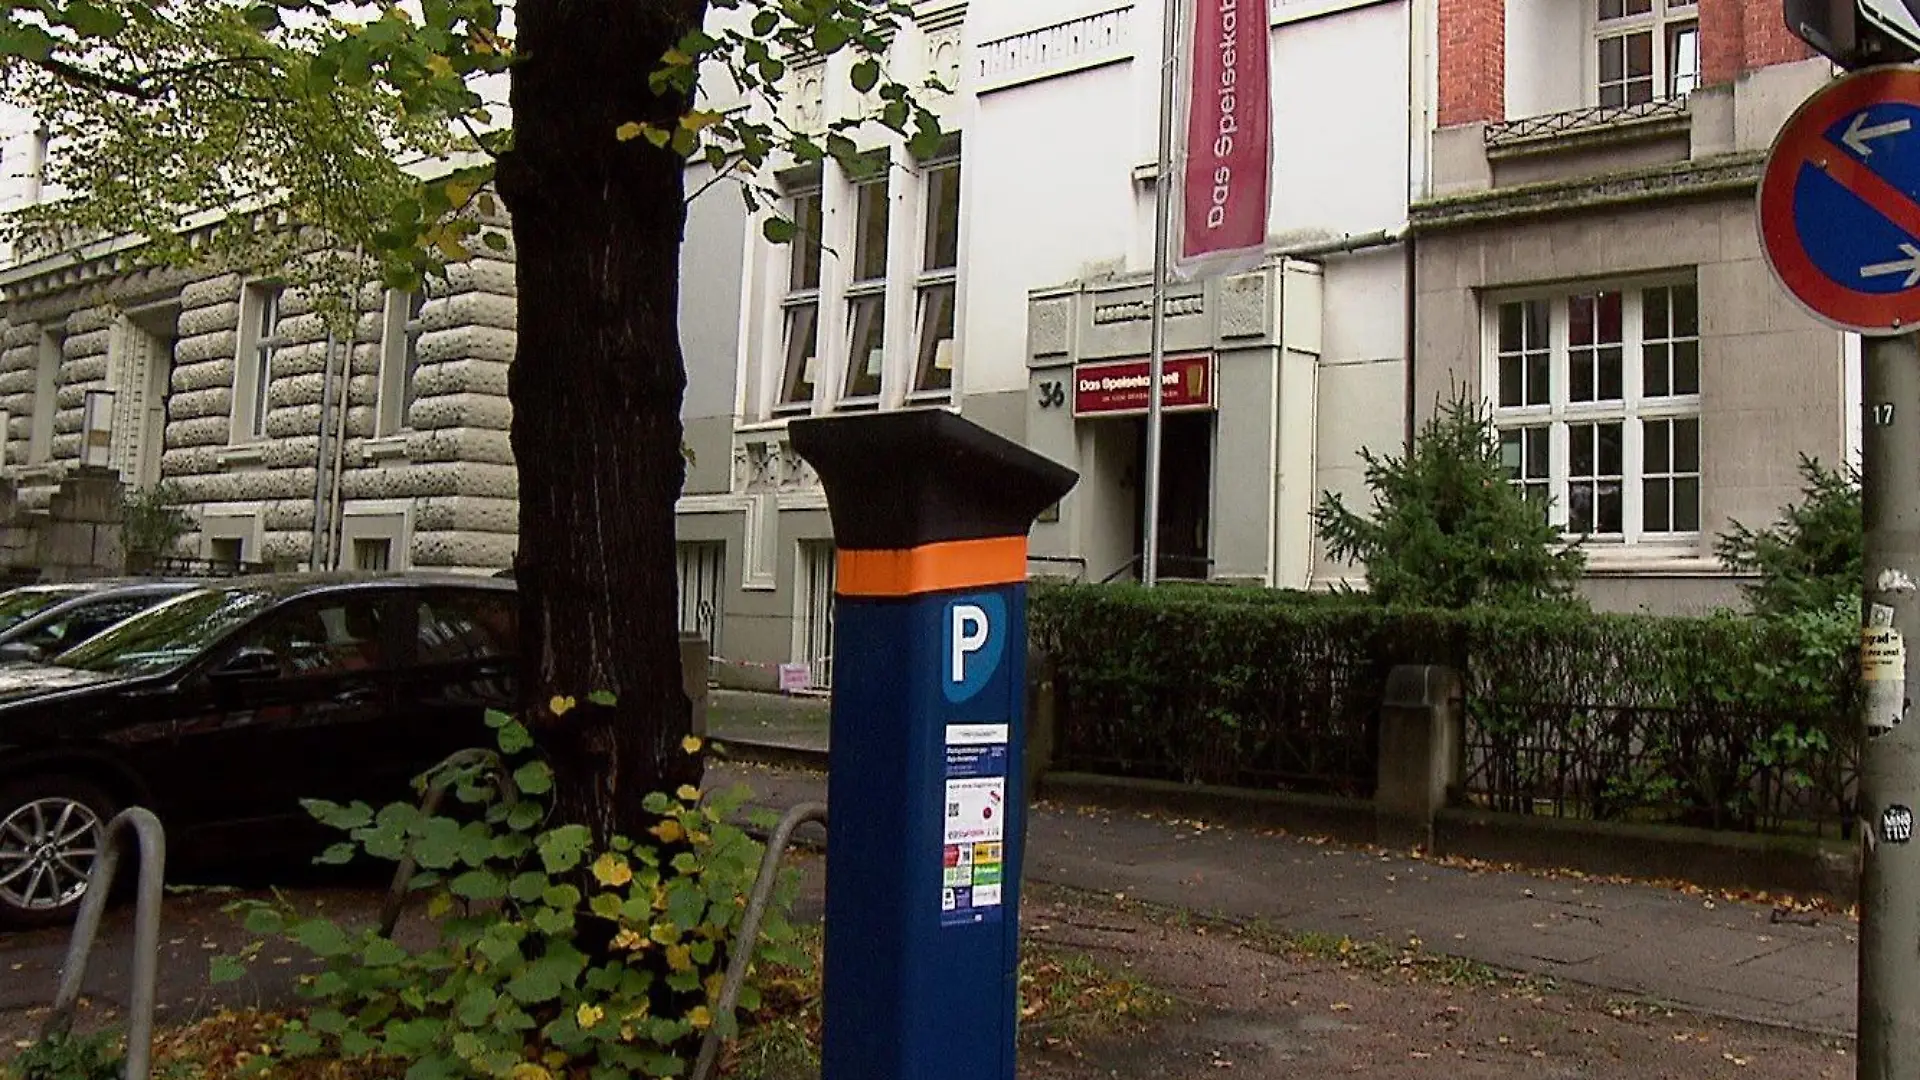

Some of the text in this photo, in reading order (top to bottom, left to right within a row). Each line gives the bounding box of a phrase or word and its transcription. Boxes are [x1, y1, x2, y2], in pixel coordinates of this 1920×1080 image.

[1208, 166, 1231, 229] Das
[1039, 381, 1064, 408] 36
[1080, 379, 1101, 392] Das
[1873, 404, 1893, 424] 17
[953, 606, 988, 681] P
